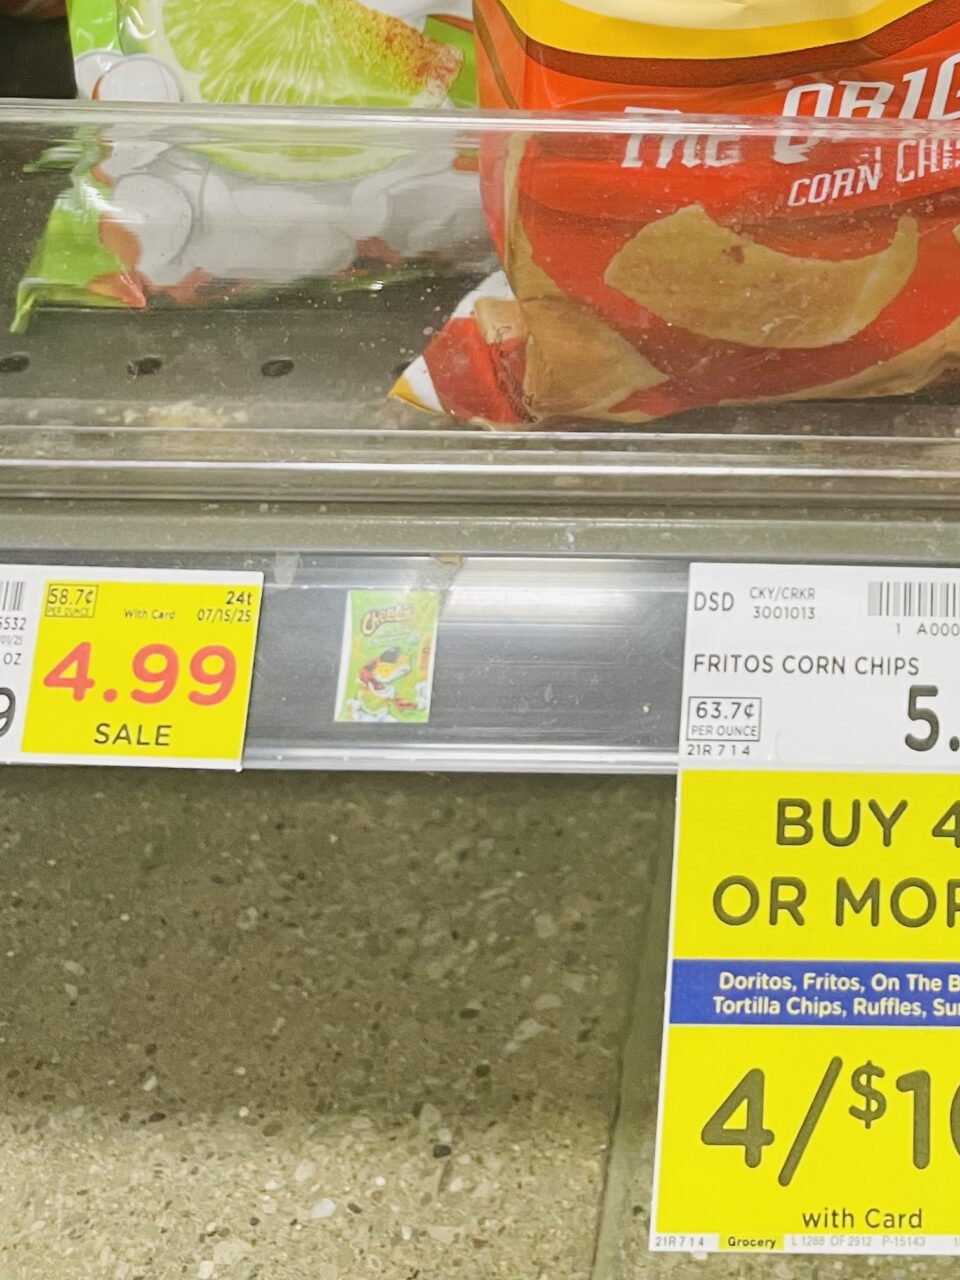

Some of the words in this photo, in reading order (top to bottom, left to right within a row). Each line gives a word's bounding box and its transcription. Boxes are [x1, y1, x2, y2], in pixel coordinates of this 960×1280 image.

[787, 146, 883, 208] CORN
[48, 586, 94, 606] 58.7¢
[693, 591, 735, 613] DSD
[749, 586, 816, 601] CKY/CRKR
[752, 606, 816, 621] 3001013
[43, 640, 237, 706] 4.99
[693, 654, 774, 675] FRITOS
[782, 655, 846, 676] CORN
[854, 656, 920, 677] CHIPS
[696, 701, 755, 721] 63.7¢
[93, 722, 173, 747] SALE
[691, 723, 712, 738] PER
[716, 724, 757, 739] OUNCE
[775, 797, 909, 848] BUY
[712, 875, 807, 927] OR
[719, 972, 798, 993] Doritos,
[803, 973, 866, 993] Fritos,
[871, 973, 900, 992] On
[906, 974, 942, 992] The
[713, 996, 781, 1015] Tortilla
[786, 998, 848, 1018] Chips,
[853, 999, 927, 1019] Ruffles,
[802, 1207, 856, 1229] with
[865, 1208, 923, 1229] Card
[727, 1235, 777, 1250] Grocery
